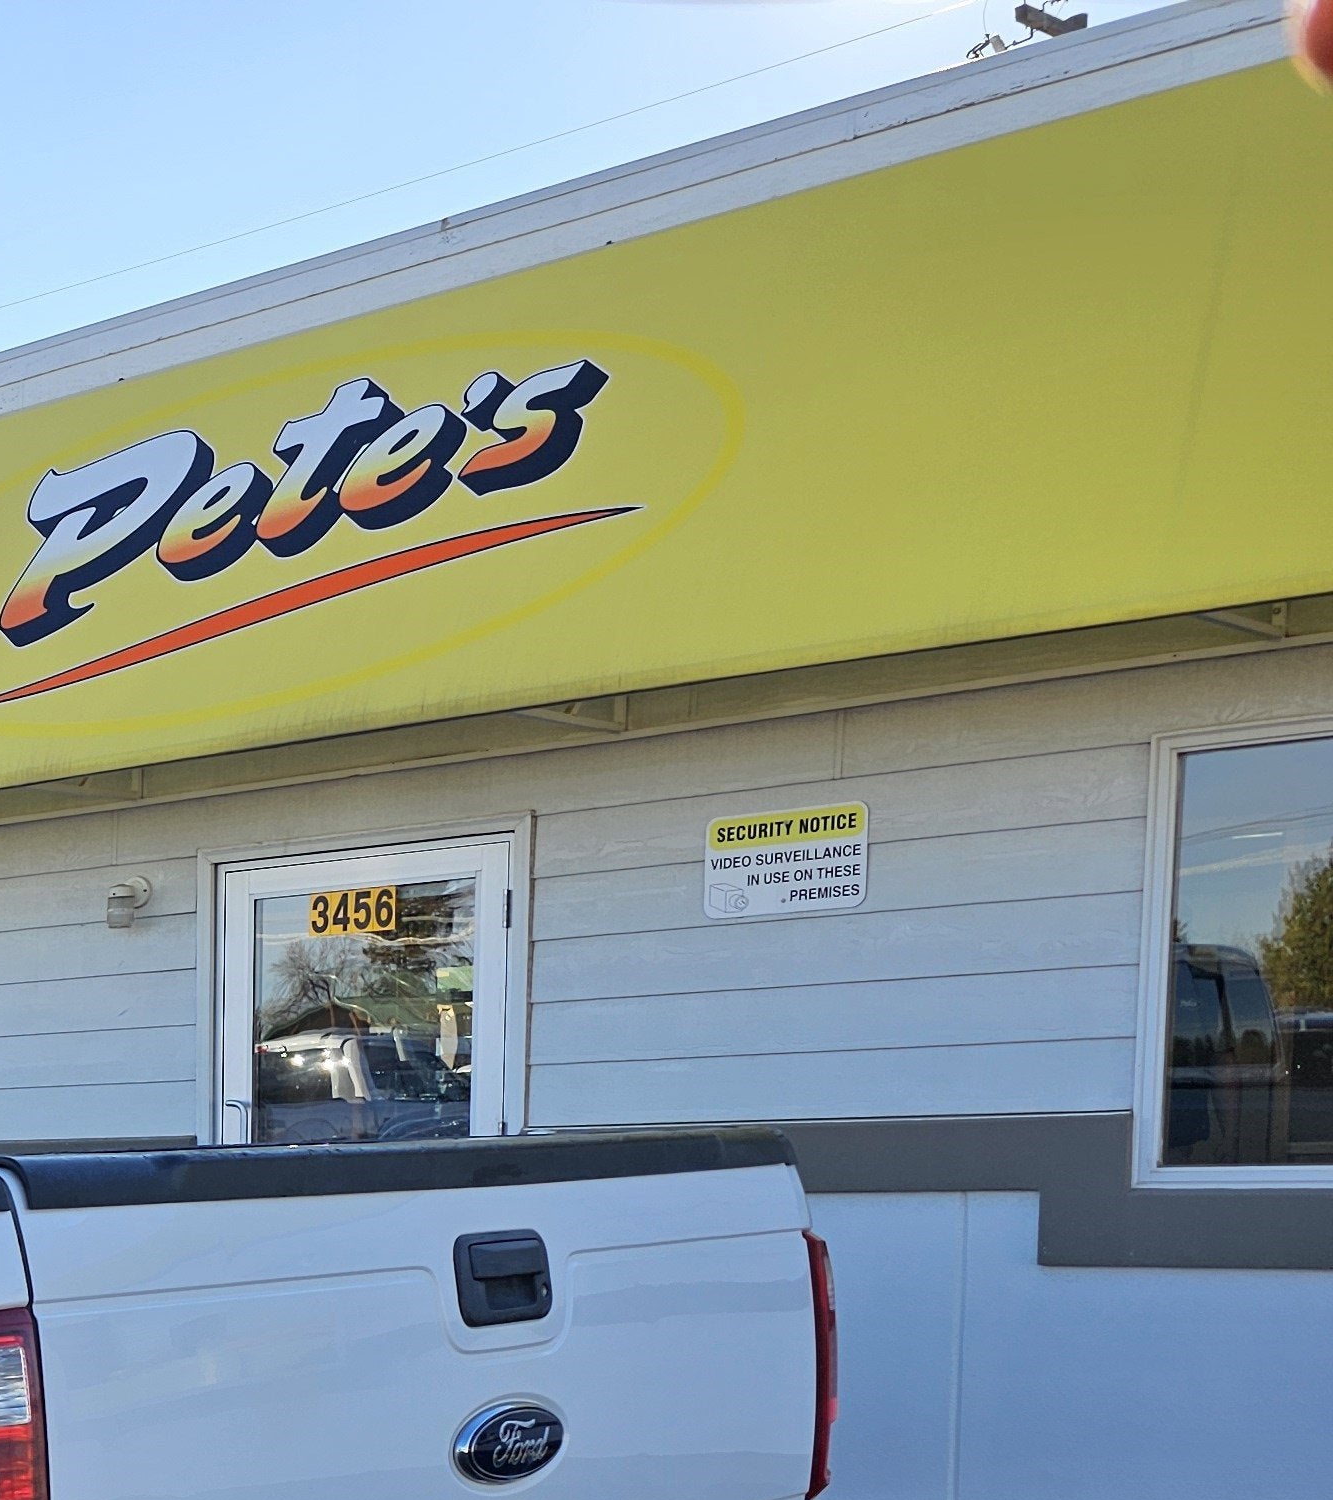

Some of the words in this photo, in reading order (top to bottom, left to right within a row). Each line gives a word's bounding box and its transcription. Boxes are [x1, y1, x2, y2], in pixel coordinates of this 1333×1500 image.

[717, 820, 793, 843] SECURITY
[799, 812, 857, 836] NOTICE
[710, 855, 751, 870] VIDEO
[755, 844, 862, 866] SURVEILLANCE
[747, 873, 760, 886] IN
[763, 871, 790, 885] USE
[793, 869, 813, 882] ON
[817, 864, 861, 880] THESE
[789, 884, 860, 902] PREMISES
[311, 888, 394, 934] 3456
[493, 1419, 550, 1468] Ford
